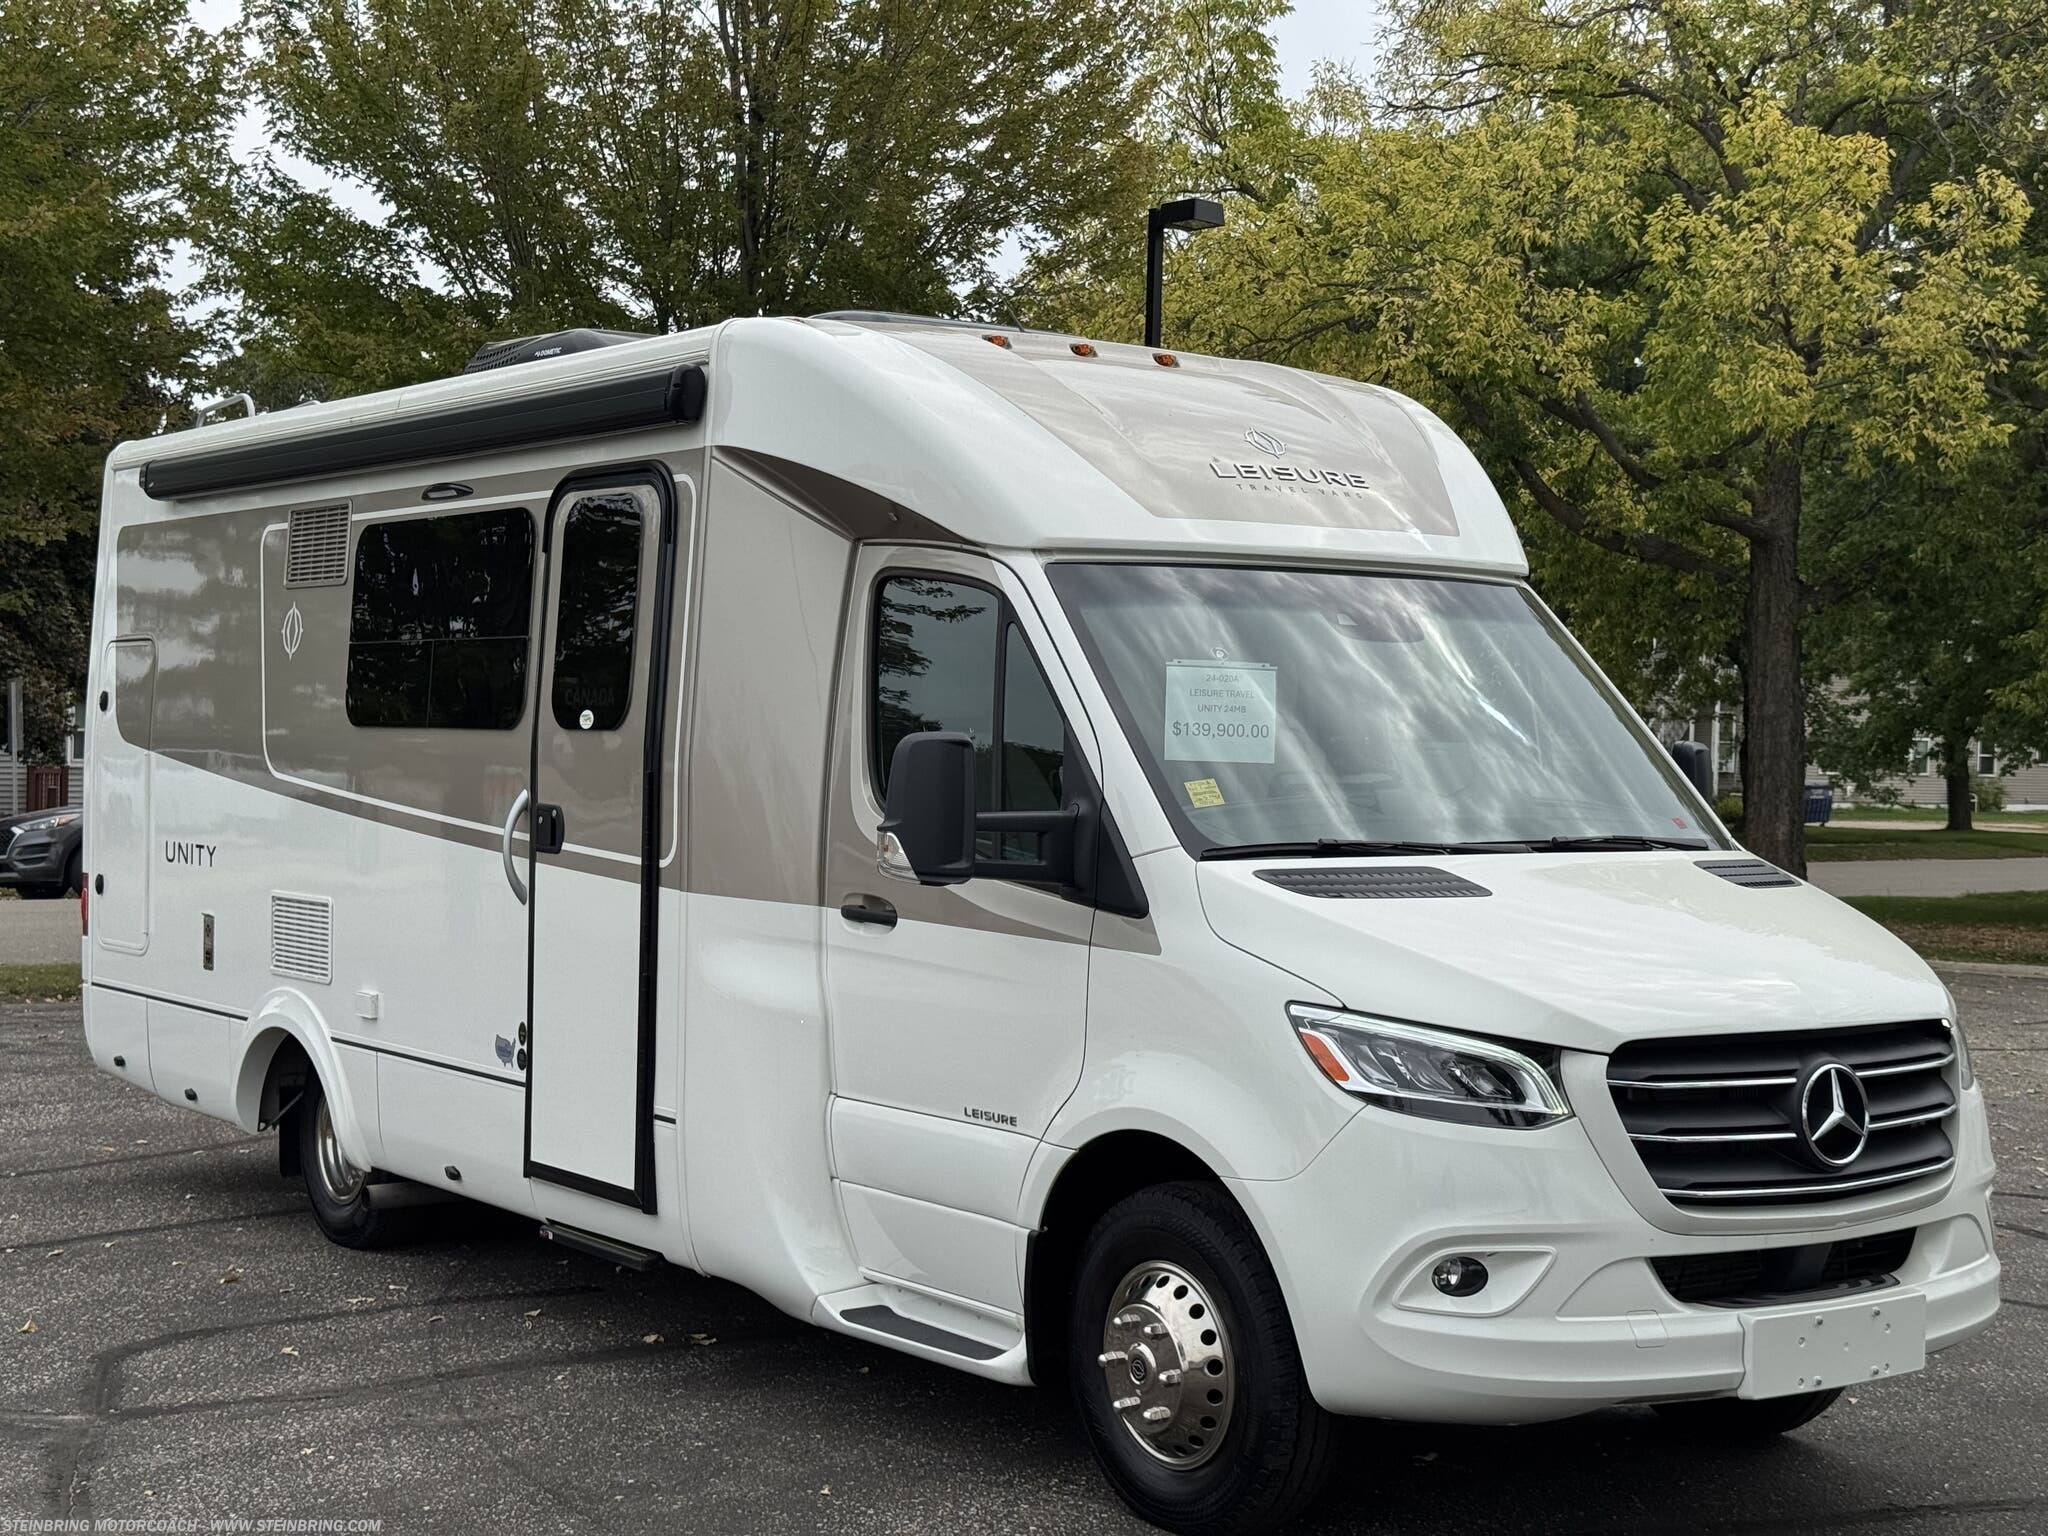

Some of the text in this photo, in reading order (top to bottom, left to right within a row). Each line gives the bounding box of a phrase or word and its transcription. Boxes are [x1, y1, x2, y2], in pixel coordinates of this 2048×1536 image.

[1209, 463, 1370, 489] LEISURE
[1236, 483, 1362, 499] TRAVEL VANS
[1189, 688, 1254, 699] LEISURE TRAVEL
[1197, 704, 1223, 713] UNITY
[1172, 720, 1270, 738] $139,900.00
[165, 840, 217, 867] UNITY
[964, 1106, 1017, 1127] LEISURE
